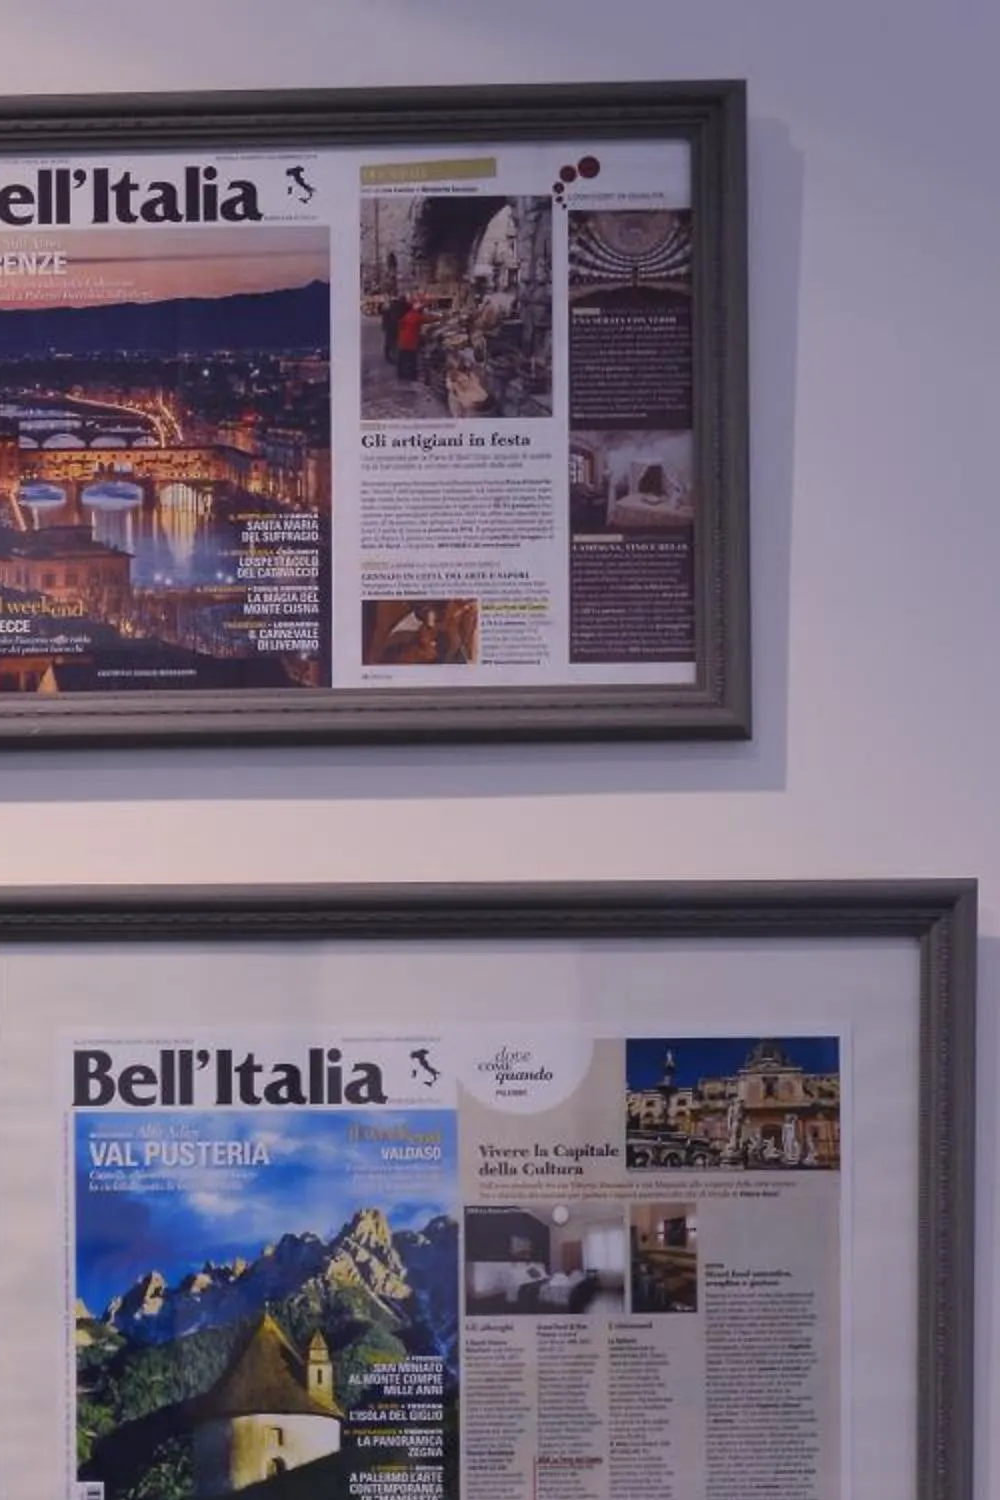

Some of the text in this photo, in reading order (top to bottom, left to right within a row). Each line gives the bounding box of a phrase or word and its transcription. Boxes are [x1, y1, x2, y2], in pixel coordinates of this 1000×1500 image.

[361, 432, 531, 450] Gli artigiani in festa
[246, 519, 319, 531] SANTA MARIA
[242, 530, 319, 542] DEL SUFFRAGIO
[237, 568, 256, 579] DEL
[247, 593, 319, 603] LA MAGIA DEL
[7, 595, 83, 618] weekend
[243, 604, 319, 614] MONTE CUSNA
[259, 630, 319, 639] CARNEVALE
[257, 640, 269, 650] DI
[72, 1048, 388, 1107] Bell'Italia
[496, 1065, 553, 1085] quando
[89, 1141, 270, 1167] VAL PUSTERIA
[381, 1147, 441, 1160] VALDASO
[479, 1144, 619, 1161] Vivere la Capitale
[479, 1162, 584, 1176] della Cultura
[349, 1373, 443, 1384] AL MONTE COMPIE
[383, 1385, 443, 1396] MILLE ANNI
[389, 1411, 408, 1421] DEL
[357, 1436, 443, 1446] LA PANORAMICA
[408, 1447, 443, 1457] ZEGNA
[349, 1473, 357, 1483] A
[360, 1472, 408, 1483] PALERMO
[349, 1484, 443, 1494] CONTEMPORANEA
